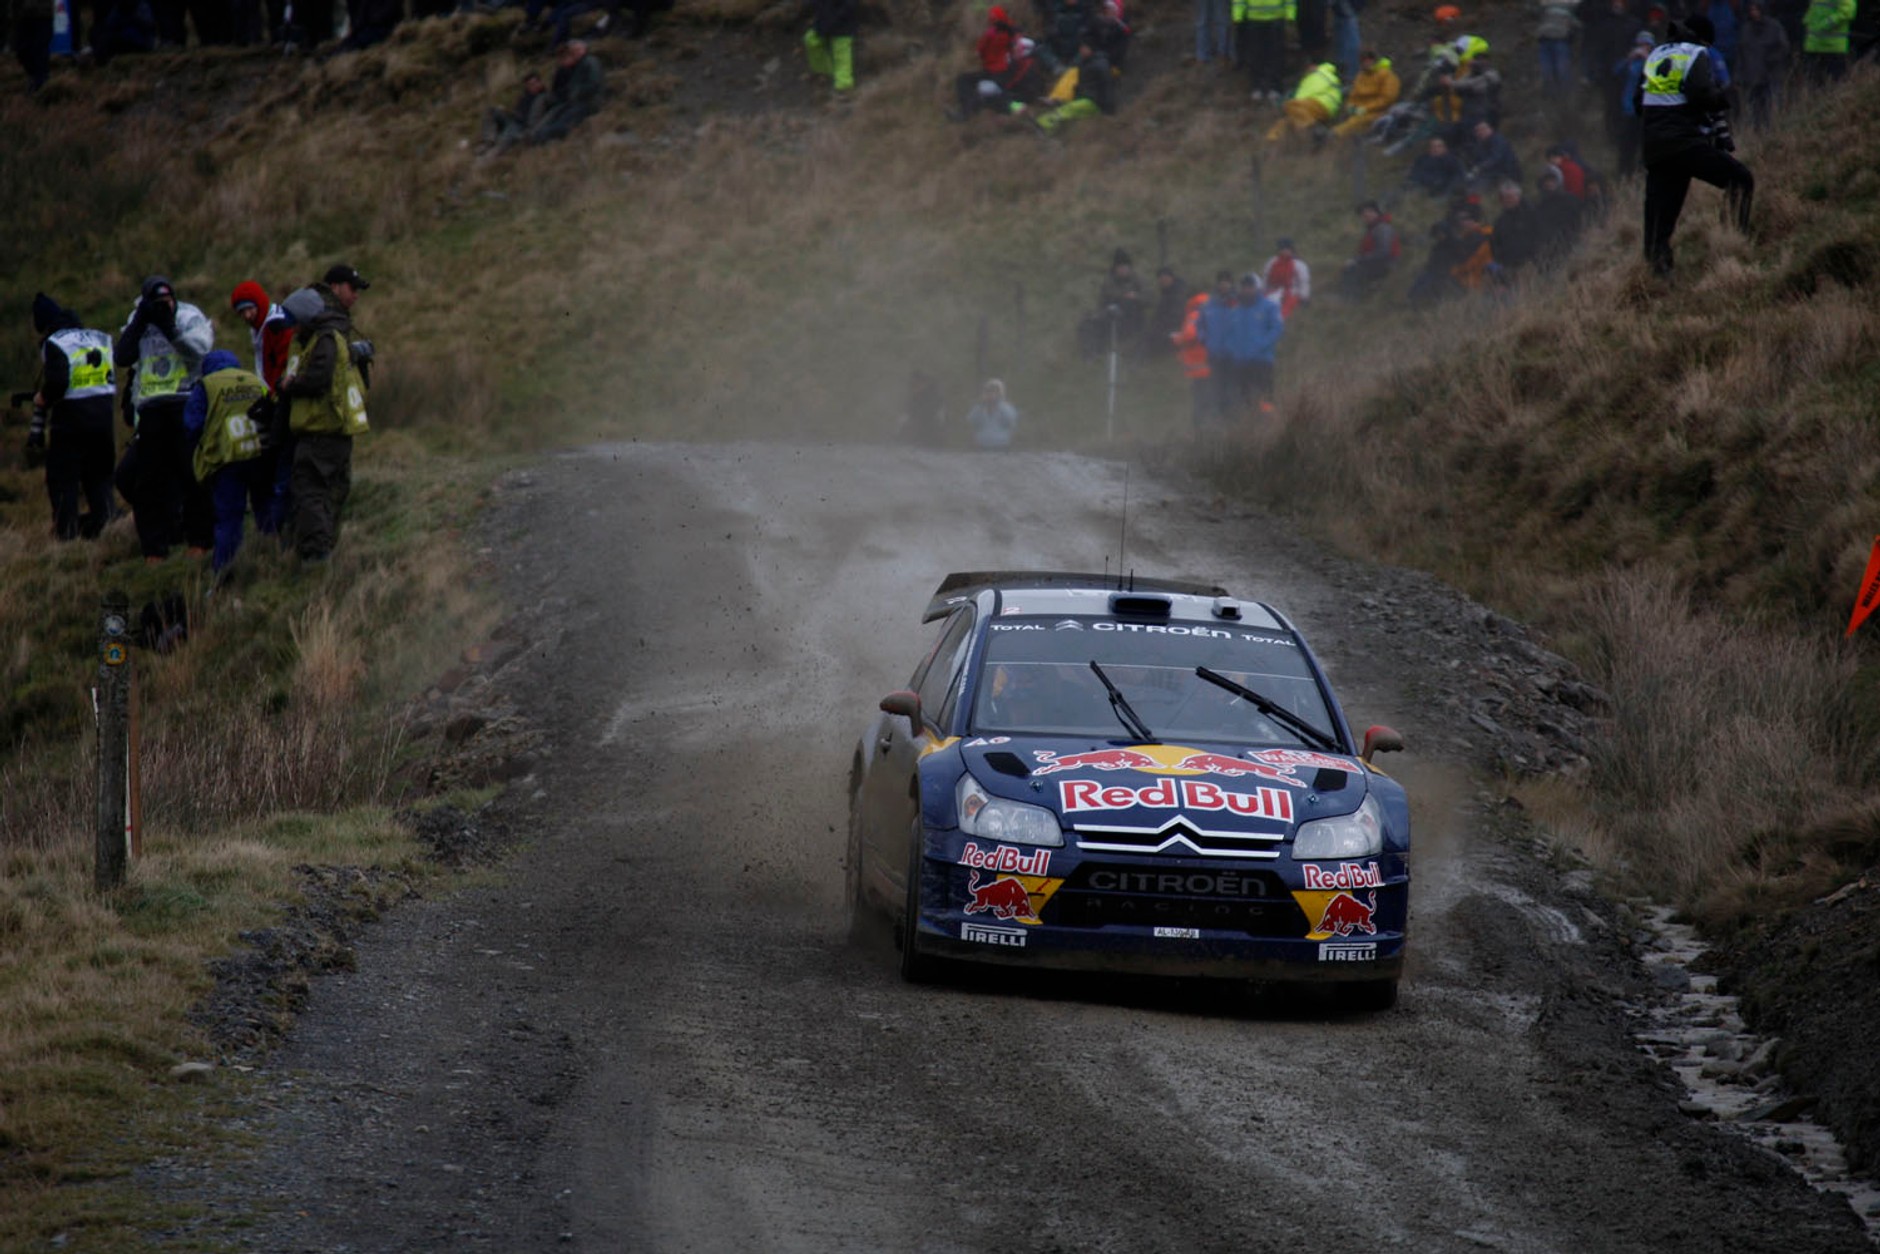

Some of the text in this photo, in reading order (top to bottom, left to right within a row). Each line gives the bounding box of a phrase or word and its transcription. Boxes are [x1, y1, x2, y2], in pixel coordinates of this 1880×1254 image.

[989, 624, 1046, 632] TOTAL
[1241, 634, 1296, 647] TOTAL
[1061, 779, 1292, 821] Red Bull
[961, 842, 1050, 876] Red Bull
[1303, 862, 1384, 889] Red Bull
[960, 922, 1028, 948] PIRELLI
[1317, 942, 1377, 962] PIRELLI
